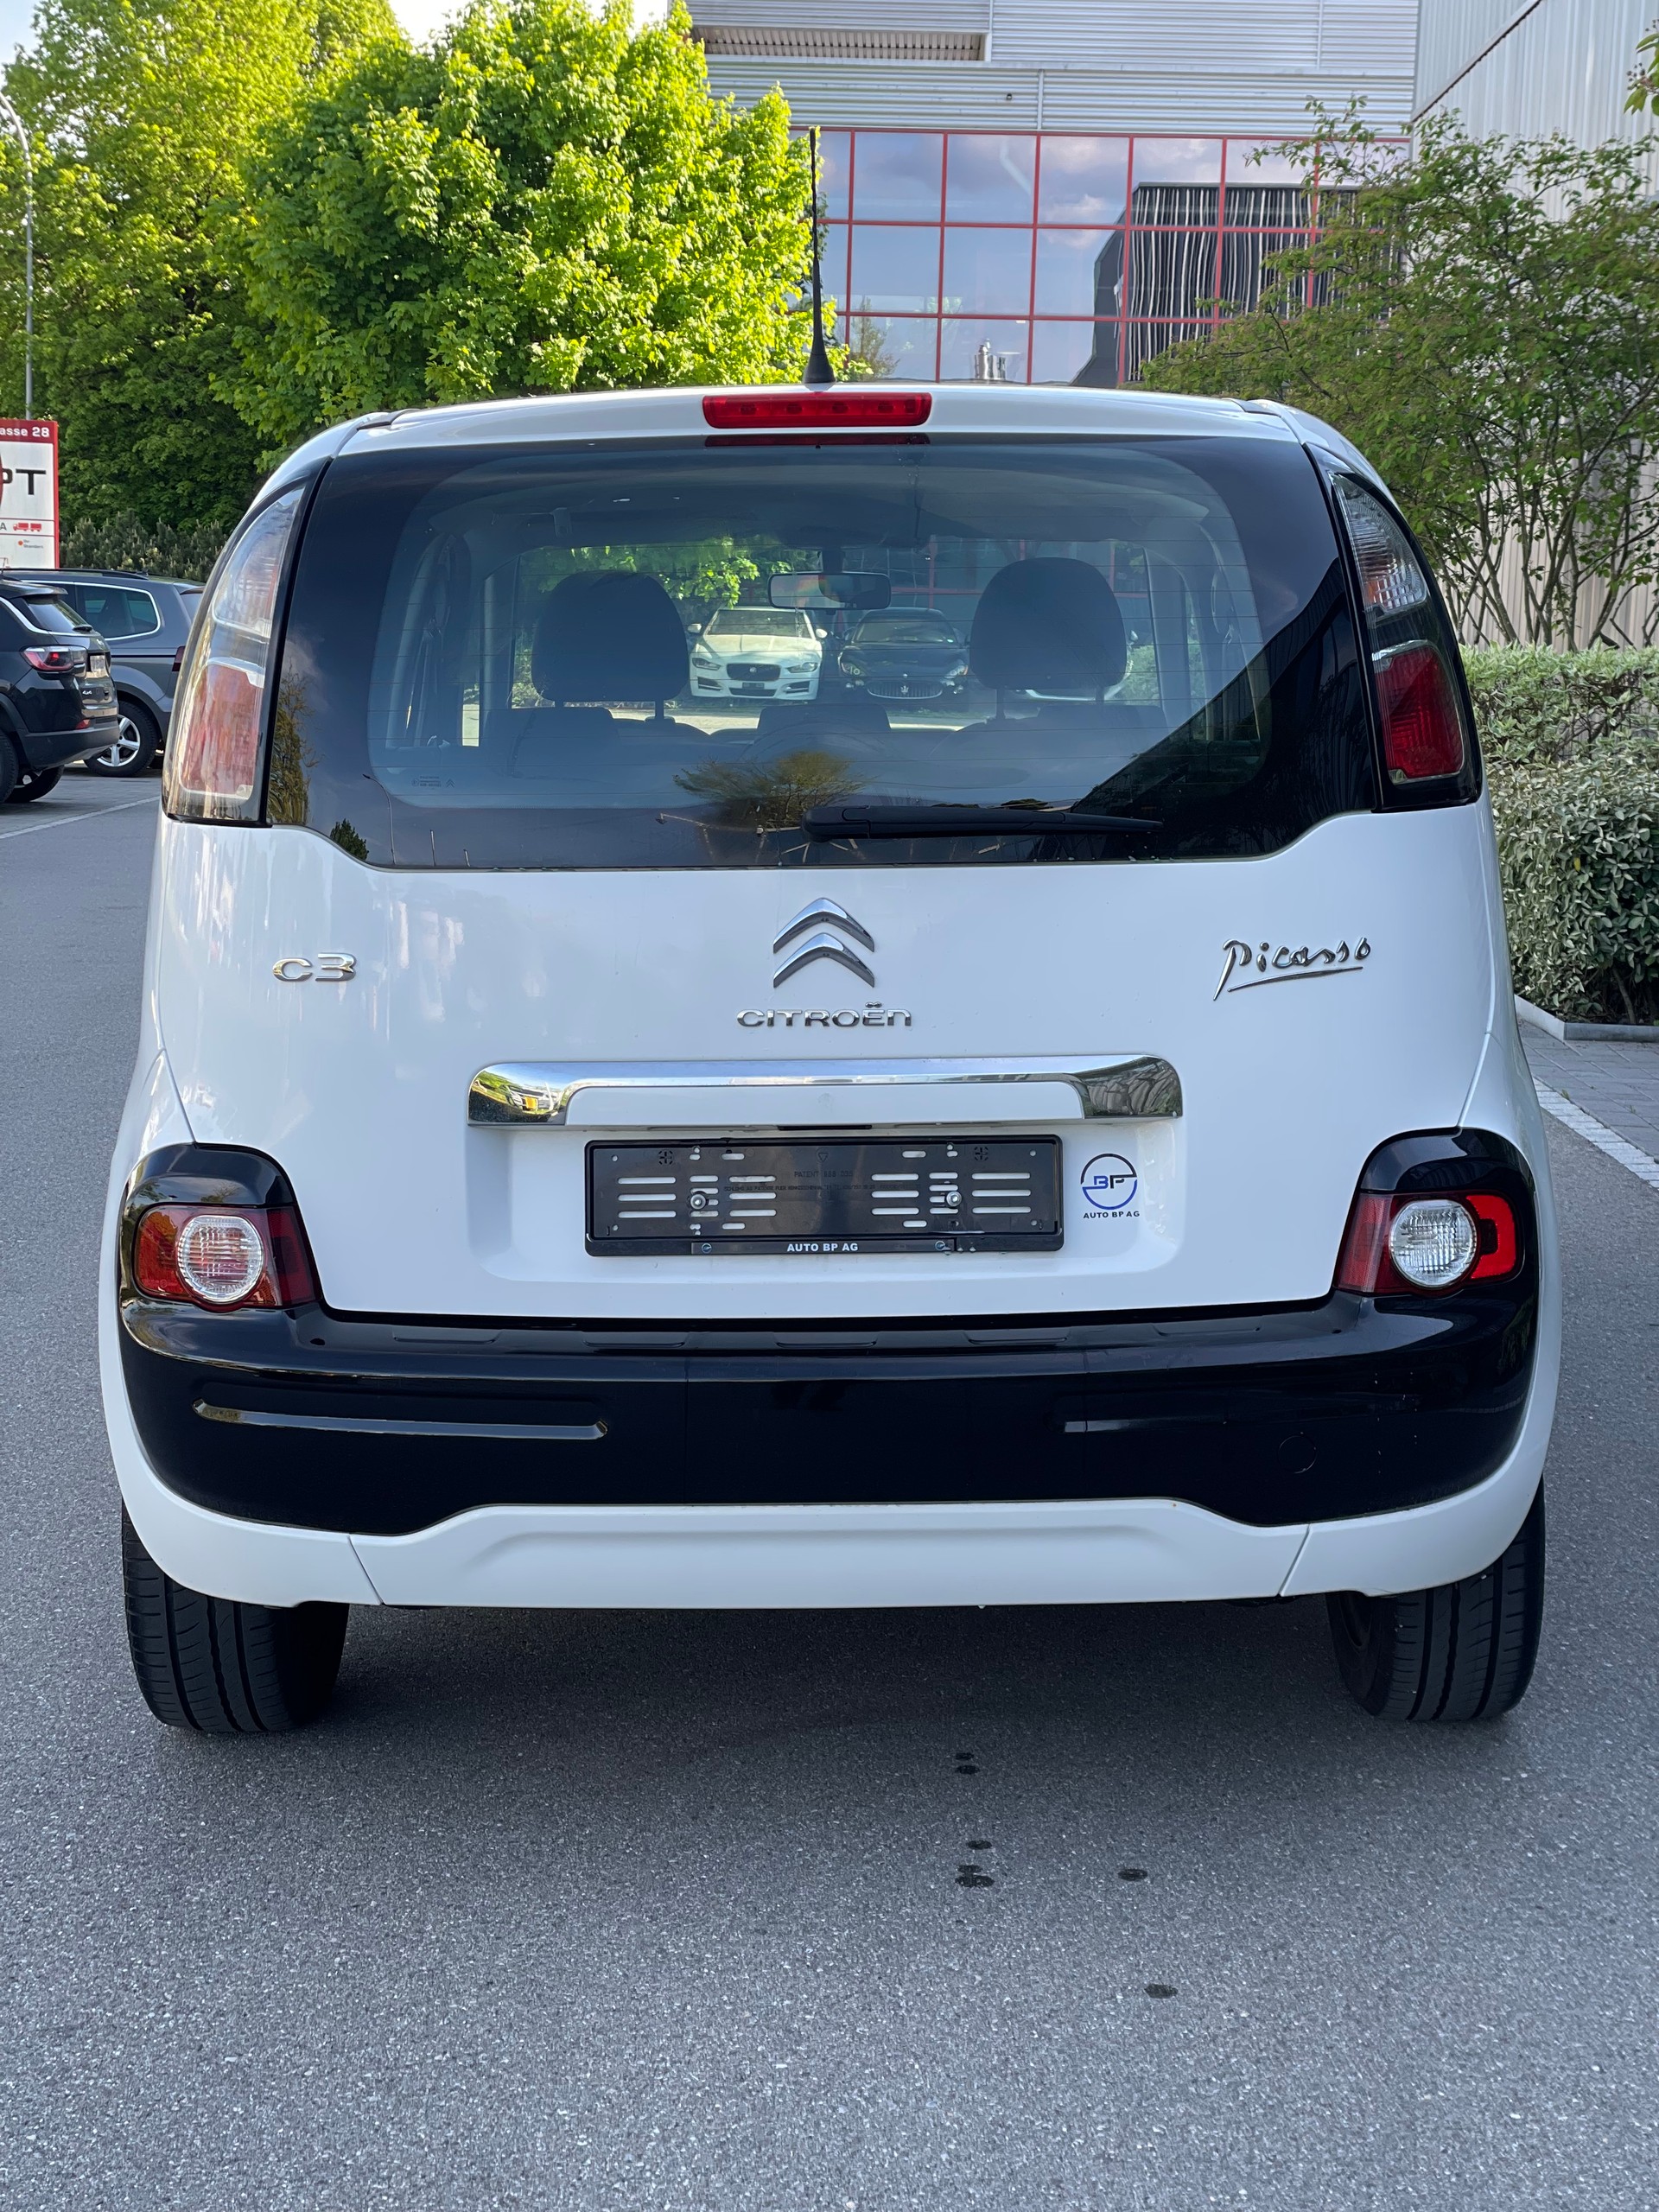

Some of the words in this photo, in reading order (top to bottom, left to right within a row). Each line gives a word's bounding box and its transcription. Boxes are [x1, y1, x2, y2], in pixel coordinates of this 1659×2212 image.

[32, 426, 50, 438] 28
[272, 952, 357, 982] C3
[1212, 937, 1371, 1001] Picasso
[786, 1243, 819, 1252] AUTO
[823, 1243, 838, 1251] BP
[842, 1243, 858, 1251] AG
